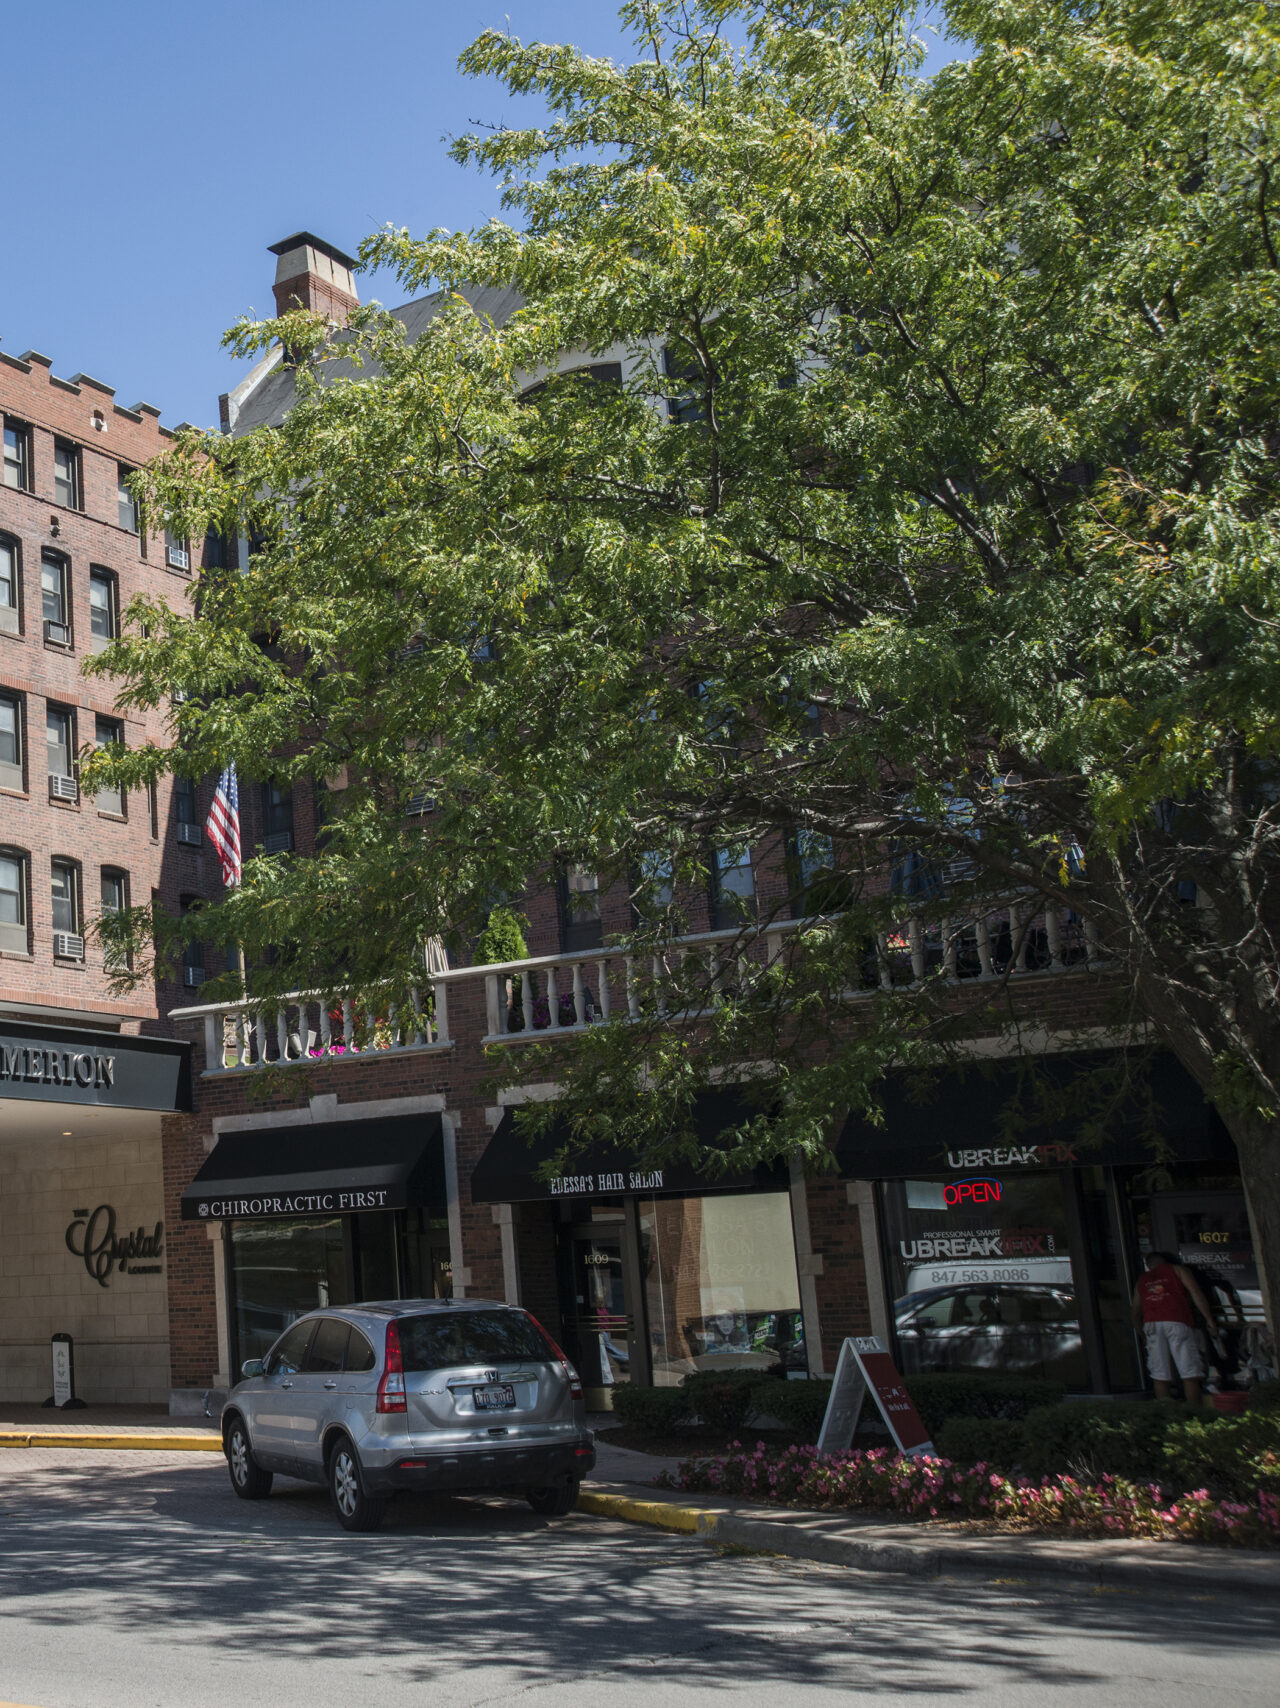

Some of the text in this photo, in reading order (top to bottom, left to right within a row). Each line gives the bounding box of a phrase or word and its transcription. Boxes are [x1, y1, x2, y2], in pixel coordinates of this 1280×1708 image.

[551, 1170, 664, 1194] EDESSA'S HAIR SALON
[943, 1182, 1000, 1205] OPEN
[210, 1190, 387, 1216] CHIROPRACTIC FIRST
[923, 1230, 973, 1239] PROFESSIONAL
[1199, 1231, 1229, 1243] 1607
[584, 1254, 609, 1265] 1609
[931, 1268, 1030, 1284] 847.563.8086
